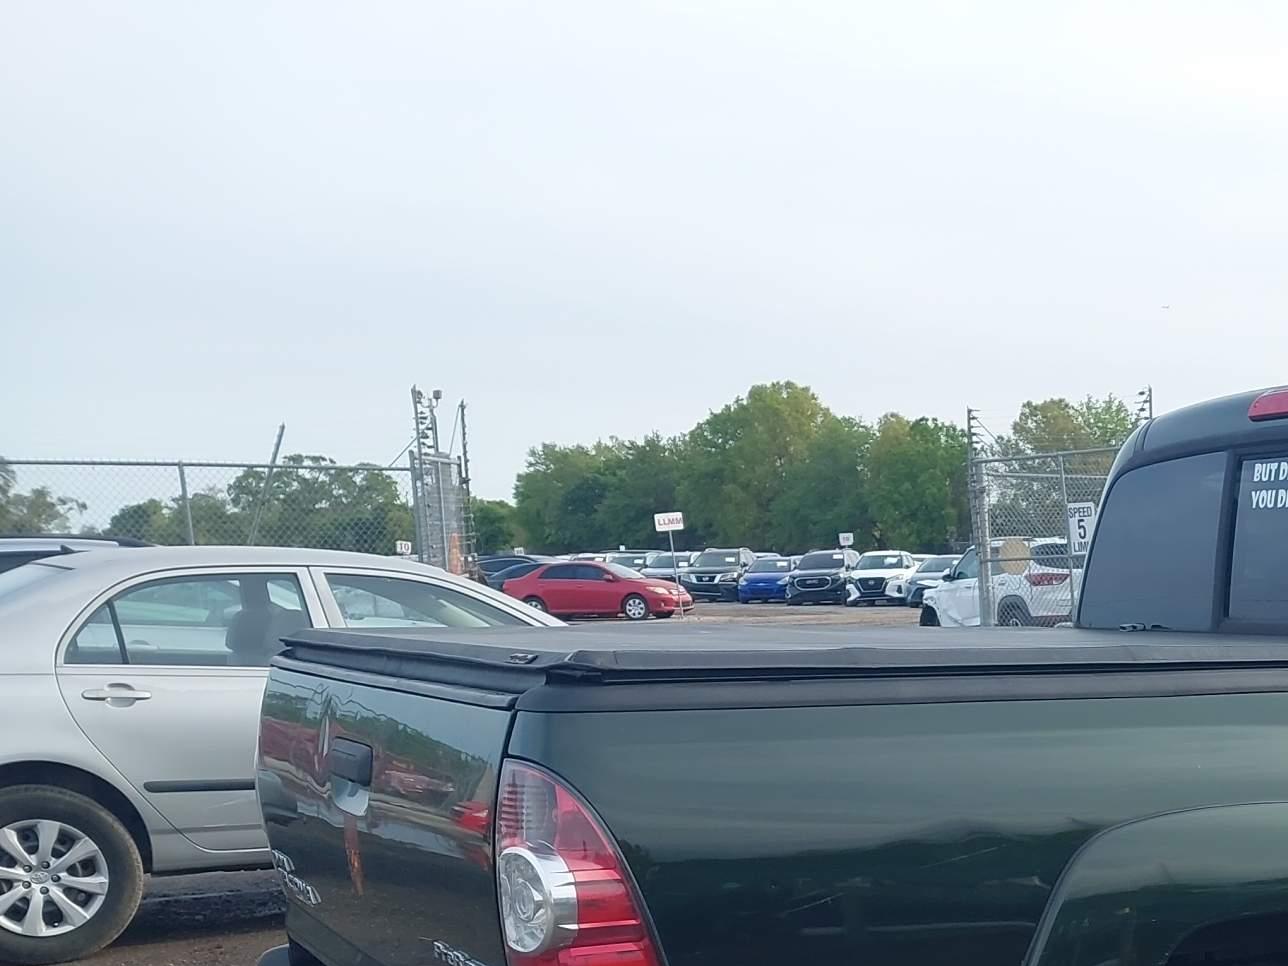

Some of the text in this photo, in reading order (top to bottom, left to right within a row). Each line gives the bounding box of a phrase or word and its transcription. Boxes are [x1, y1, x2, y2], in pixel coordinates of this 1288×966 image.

[1253, 462, 1279, 482] BUT
[1251, 489, 1276, 509] YOU
[1068, 506, 1092, 518] SPEED
[1077, 518, 1087, 540] 5
[1073, 541, 1088, 553] LIM
